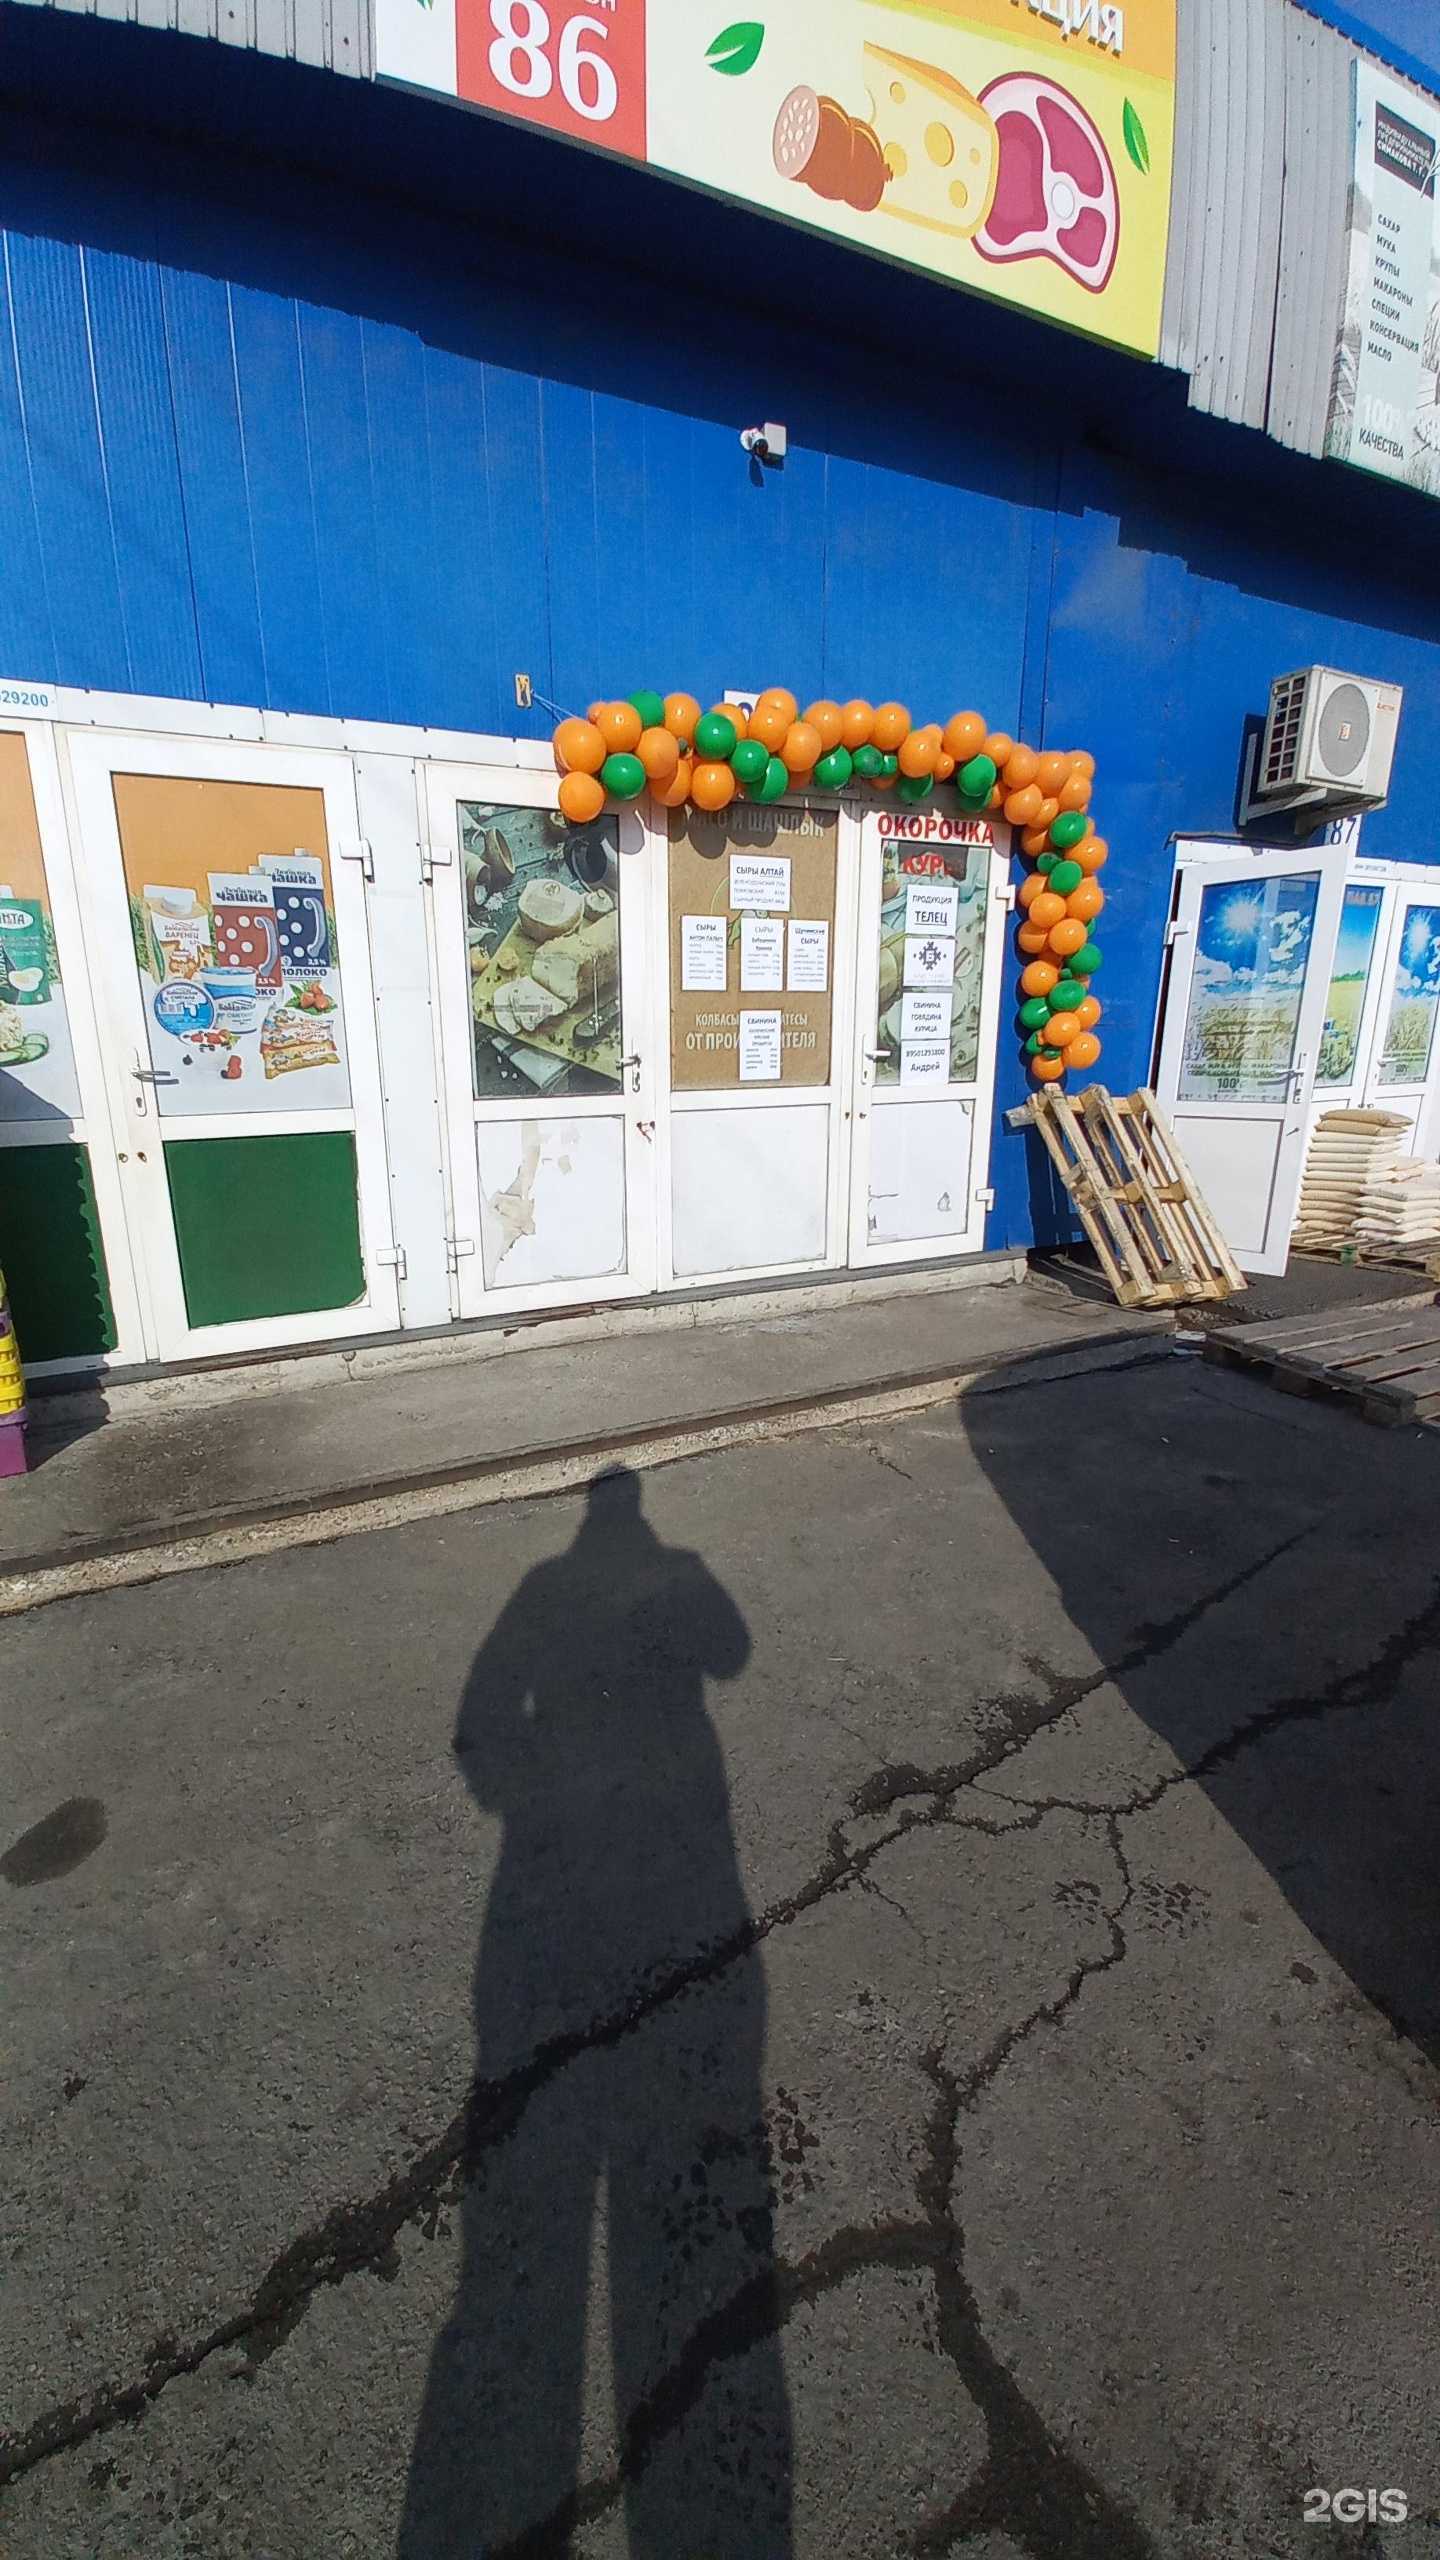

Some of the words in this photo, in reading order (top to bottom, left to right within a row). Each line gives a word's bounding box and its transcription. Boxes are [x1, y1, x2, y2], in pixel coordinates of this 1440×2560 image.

[489, 0, 618, 121] 86
[1377, 212, 1401, 234] САХАР
[1376, 234, 1397, 255] МУКА
[1375, 255, 1400, 278] КРУПЫ
[1373, 276, 1415, 308] МАКАРОНЫ
[1371, 298, 1400, 323] СПЕЦИИ
[1369, 319, 1420, 354] КОНСЕРВАЦИЯ
[1367, 341, 1393, 363] МАСЛО
[1360, 427, 1405, 461] КАЧЕСТВА
[0, 689, 49, 708] 29200
[878, 814, 994, 844] ОКОРОЧКА
[1330, 816, 1357, 846] 87
[736, 866, 759, 875] СЫРЫ
[760, 866, 785, 877] АЛТАЙ
[912, 895, 953, 904] ПРОДУКЦИЯ
[696, 923, 717, 931] СЫРЫ
[915, 910, 948, 926] ТЕЛЕЦ
